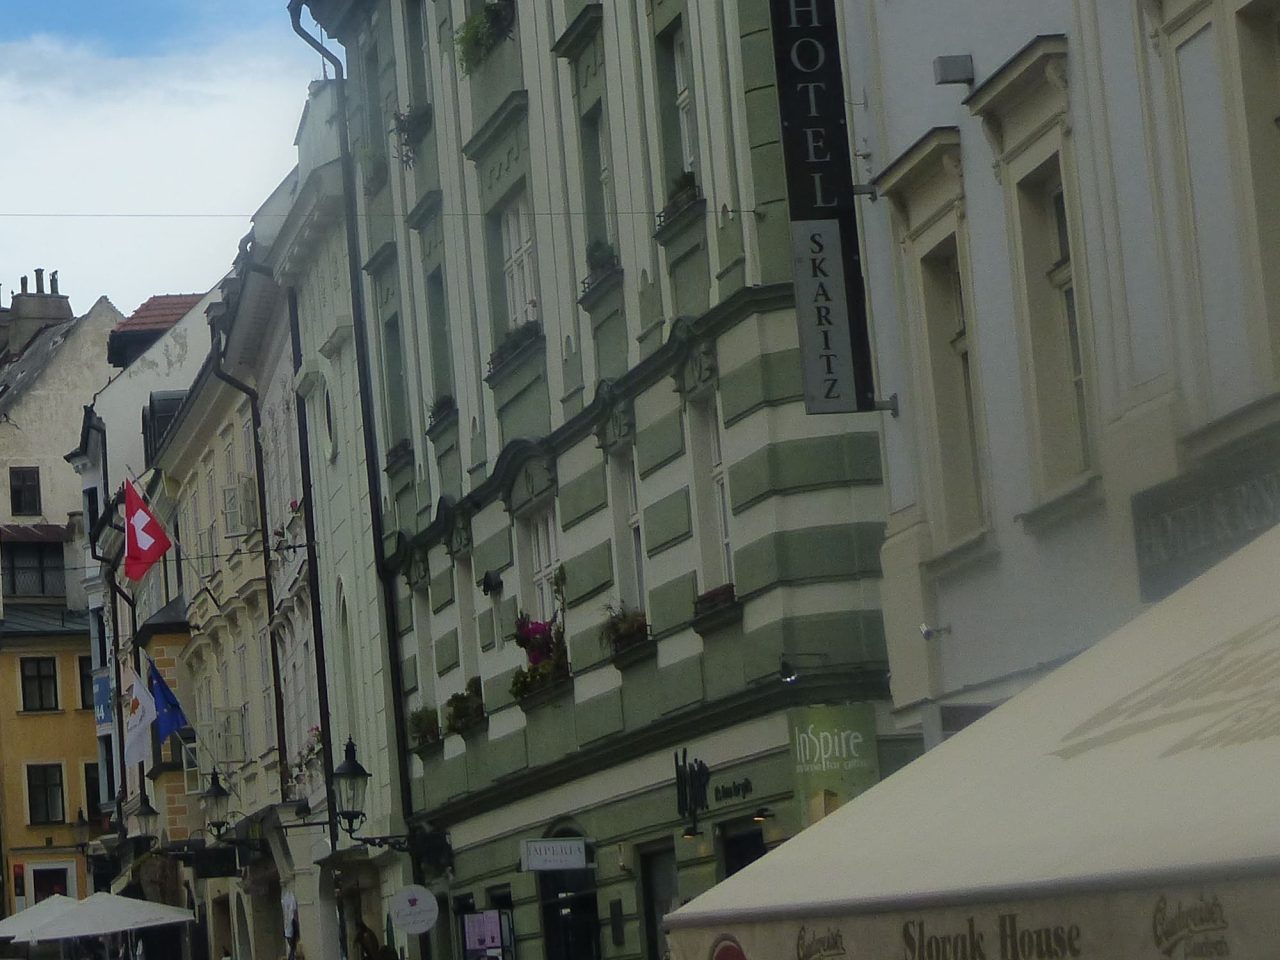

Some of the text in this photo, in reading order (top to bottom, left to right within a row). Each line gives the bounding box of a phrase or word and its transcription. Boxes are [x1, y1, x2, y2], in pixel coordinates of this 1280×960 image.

[809, 232, 841, 401] SKARITZ
[794, 723, 864, 772] InSpire
[998, 913, 1081, 960] House
